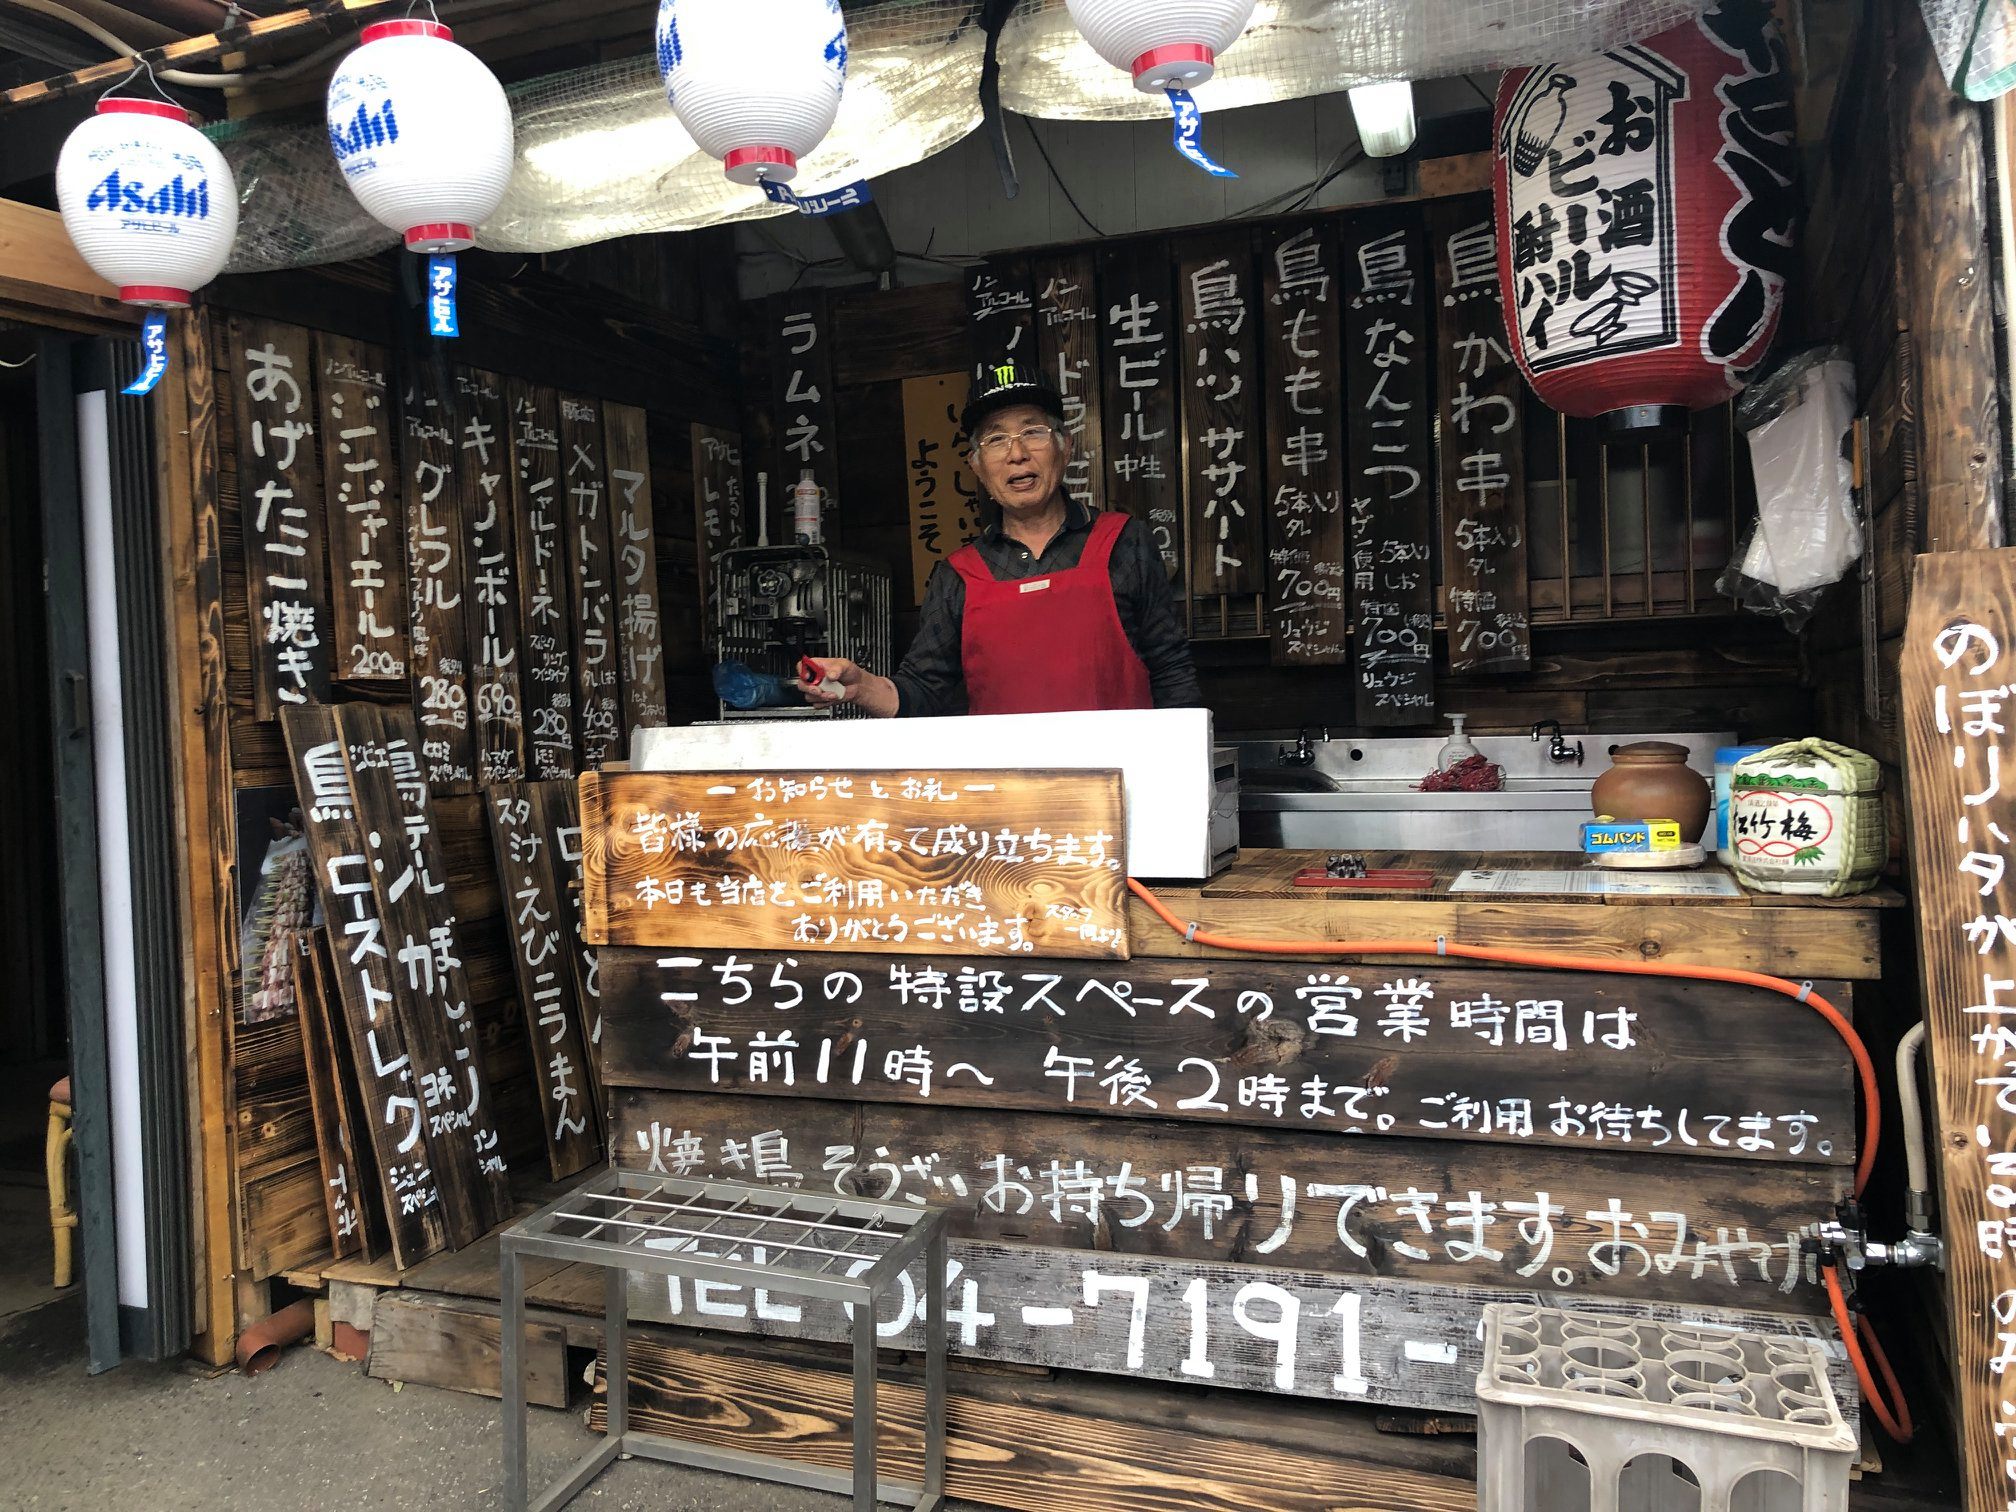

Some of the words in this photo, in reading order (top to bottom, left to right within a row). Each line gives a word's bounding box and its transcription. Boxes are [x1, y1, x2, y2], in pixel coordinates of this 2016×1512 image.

[1596, 80, 1657, 254] お酒
[86, 168, 209, 219] Asahi
[1546, 129, 1612, 306] ビール
[1512, 202, 1562, 350] 酎ハイ
[1109, 293, 1168, 441] 生ビール
[1270, 228, 1331, 477] 鳥もも串
[1350, 229, 1421, 500] 鳥なんこつ
[1443, 222, 1515, 508] 鳥かわ串
[781, 312, 824, 462] ラムネ
[1114, 453, 1166, 482] 中生
[330, 392, 396, 638] ジンジャーエール
[1273, 485, 1341, 518] 5本入り
[1453, 519, 1522, 551] 5本入り
[1276, 569, 1343, 602] 700円
[1384, 572, 1422, 595] しお
[350, 643, 405, 675] 200円
[1361, 621, 1433, 664] 700円
[1591, 831, 1646, 846] ゴムバンド
[790, 911, 1034, 952] ありがとうございます。
